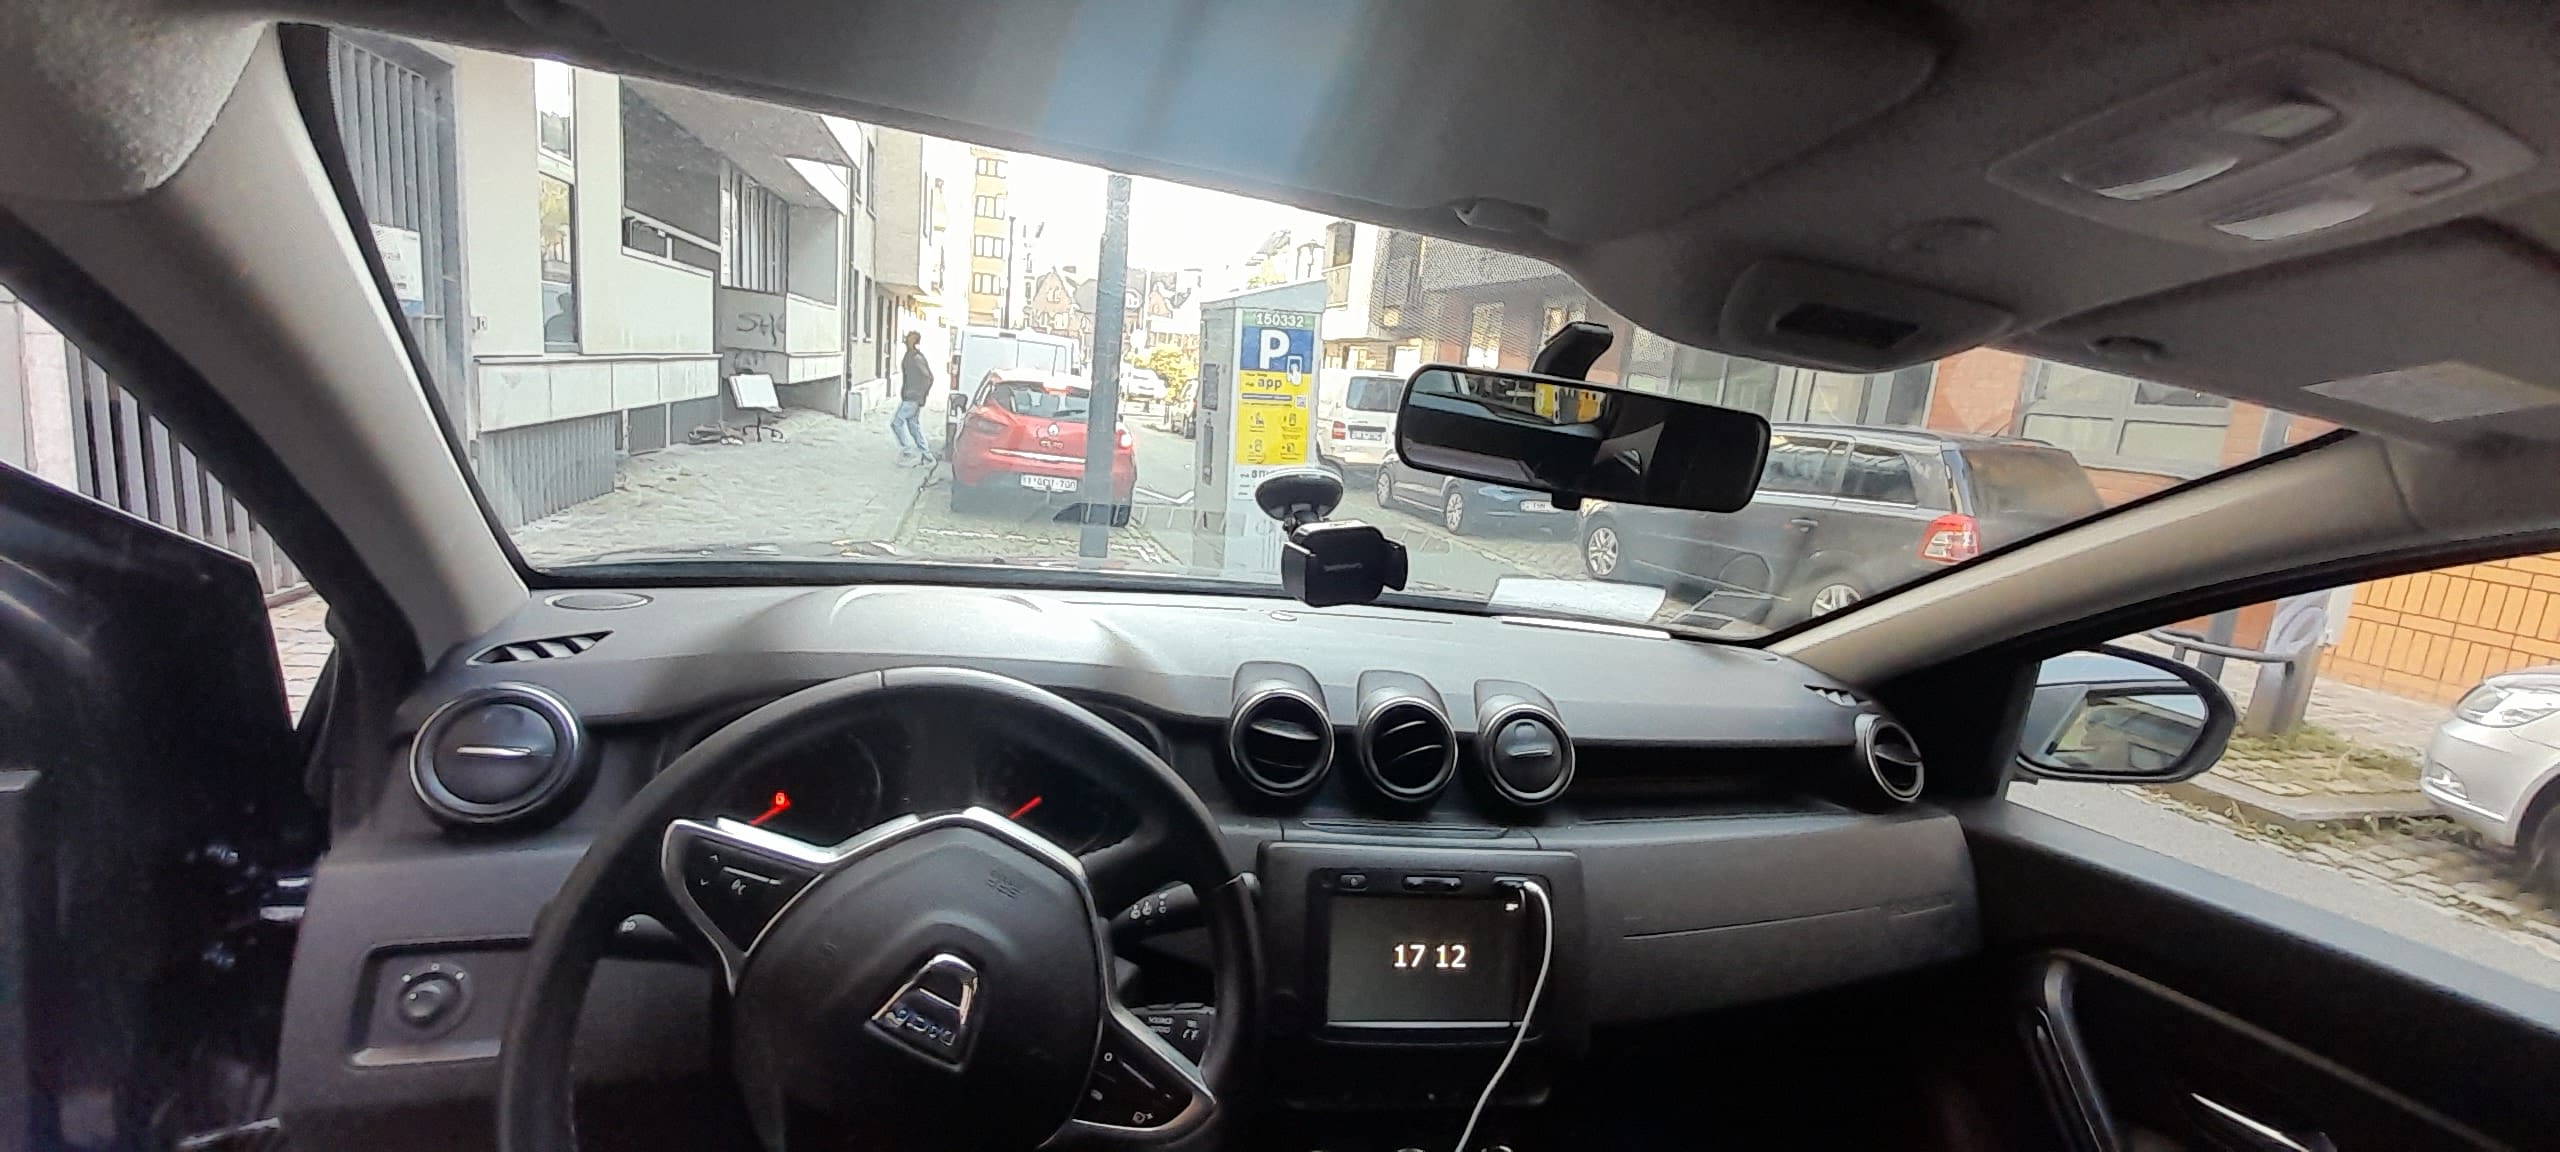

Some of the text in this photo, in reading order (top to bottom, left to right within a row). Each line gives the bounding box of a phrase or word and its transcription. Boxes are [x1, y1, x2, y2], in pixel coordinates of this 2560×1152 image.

[1256, 312, 1304, 328] 150332
[1259, 329, 1290, 370] P
[1257, 379, 1282, 391] app
[1393, 944, 1467, 968] 17 12
